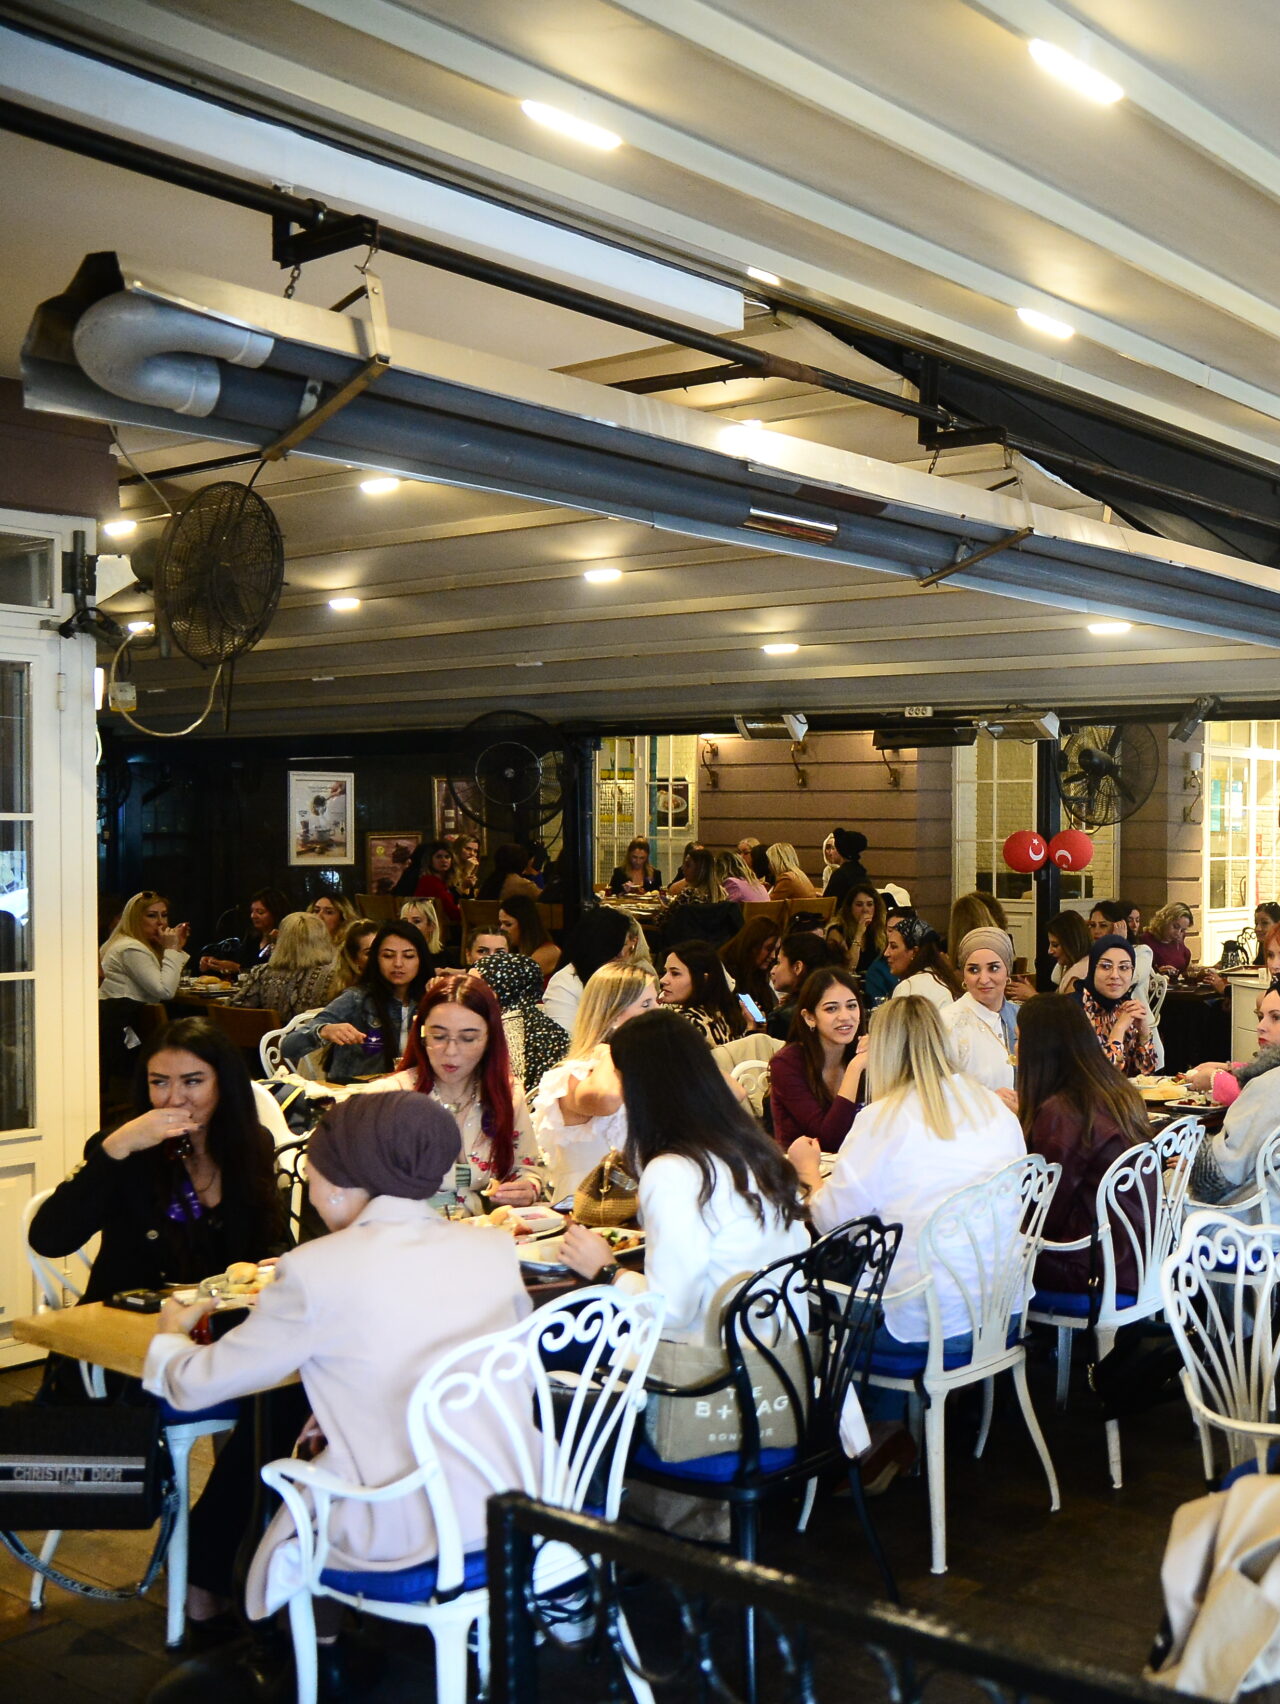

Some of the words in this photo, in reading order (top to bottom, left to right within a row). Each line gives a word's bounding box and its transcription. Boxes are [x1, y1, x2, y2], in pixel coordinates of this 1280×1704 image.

[727, 1387, 763, 1400] TE
[13, 1467, 85, 1481] CHRISTIAN
[91, 1468, 123, 1481] DIOR
